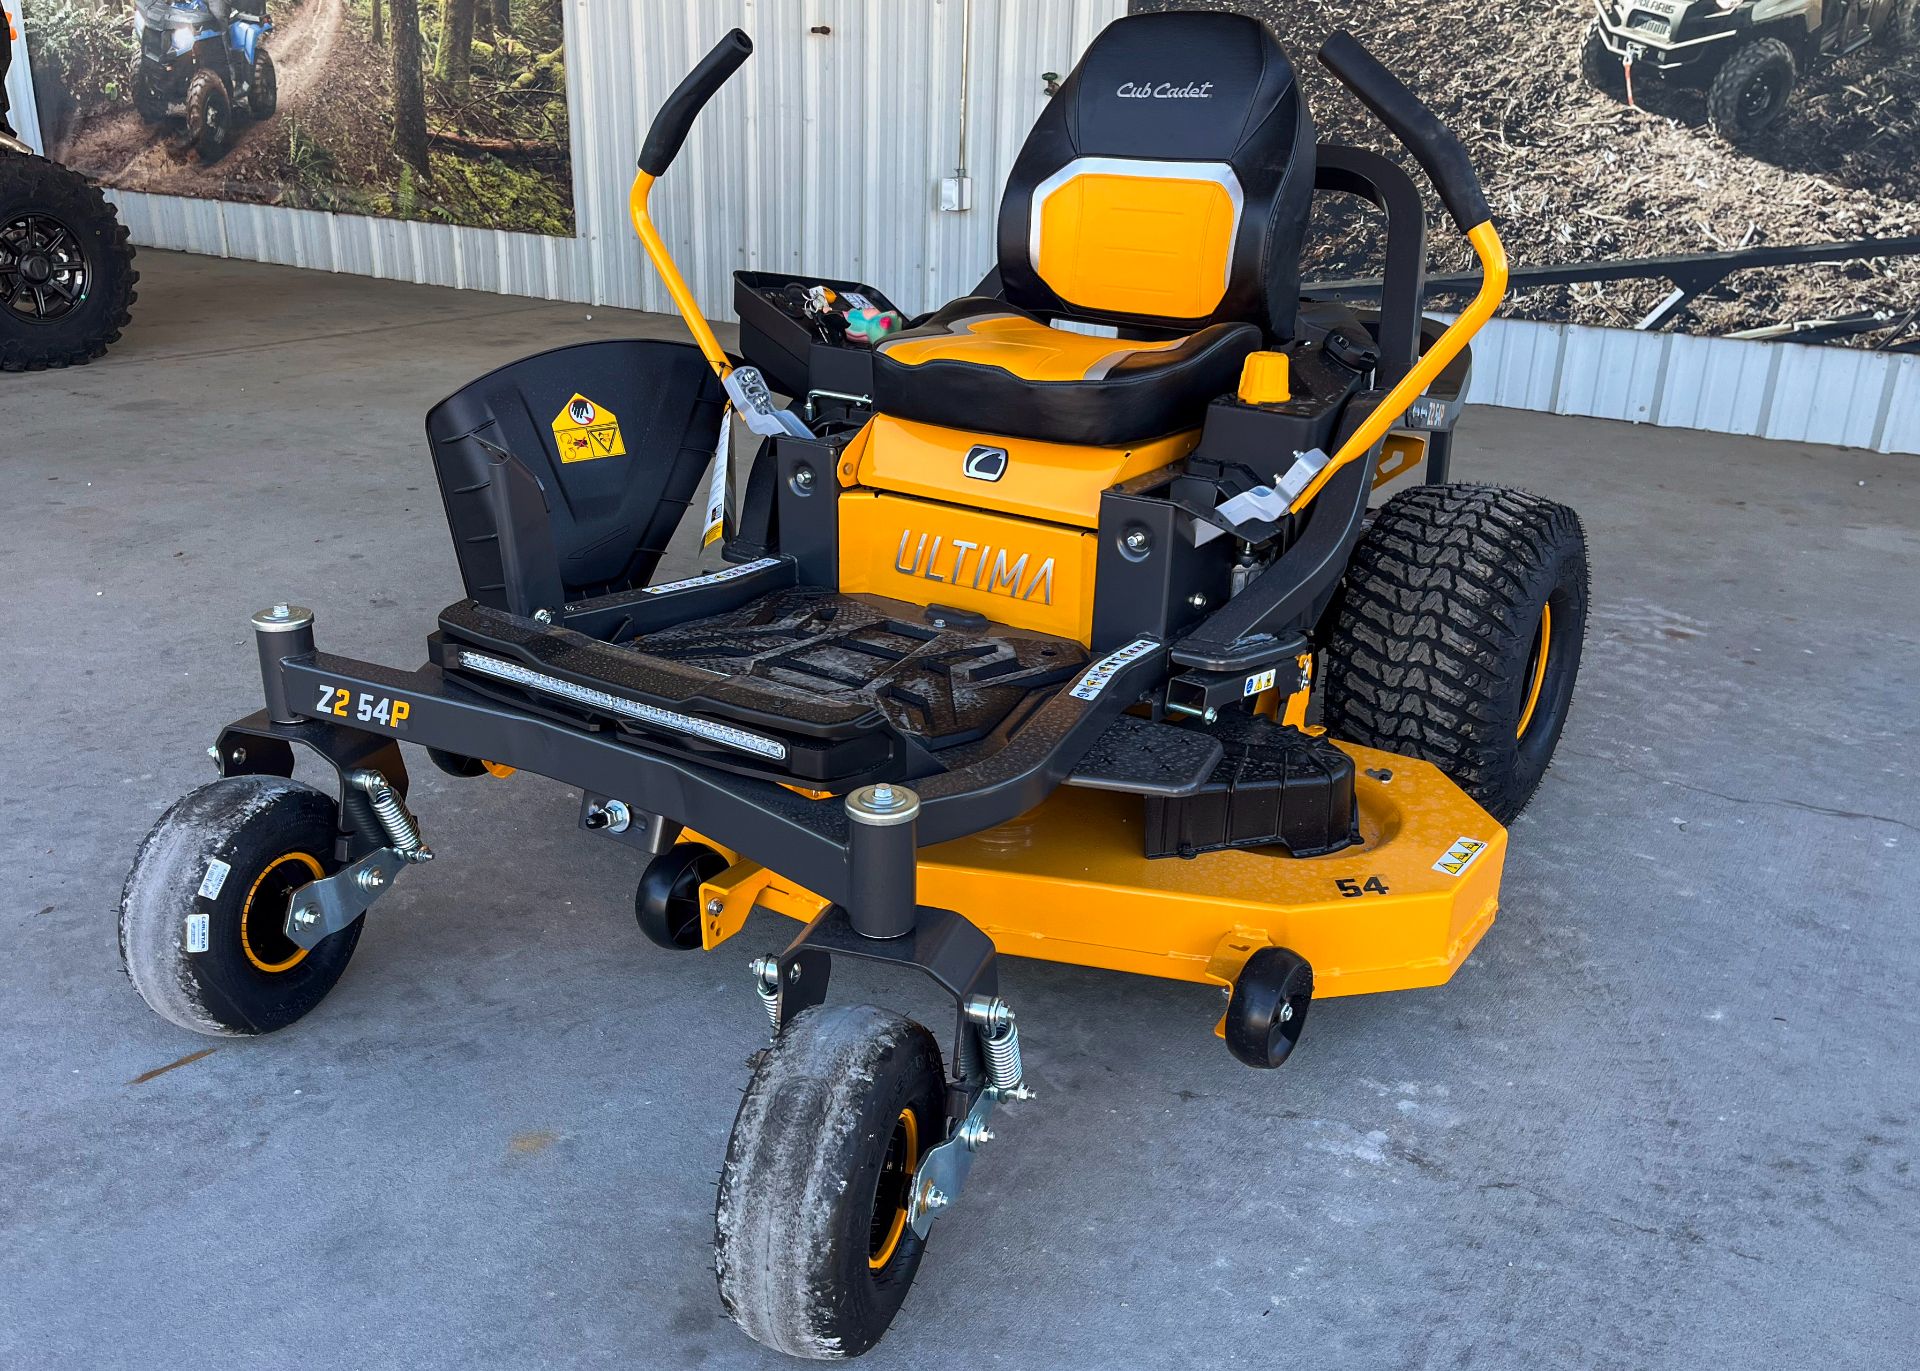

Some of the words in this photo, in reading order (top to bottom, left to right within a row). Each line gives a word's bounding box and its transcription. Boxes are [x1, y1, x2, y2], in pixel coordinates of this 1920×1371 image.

[1116, 82, 1152, 98] Cub
[1153, 81, 1214, 98] Cadet
[895, 529, 1055, 605] ULTIMA
[316, 684, 351, 717] Z2
[356, 693, 410, 728] 54P
[1335, 876, 1390, 897] 54
